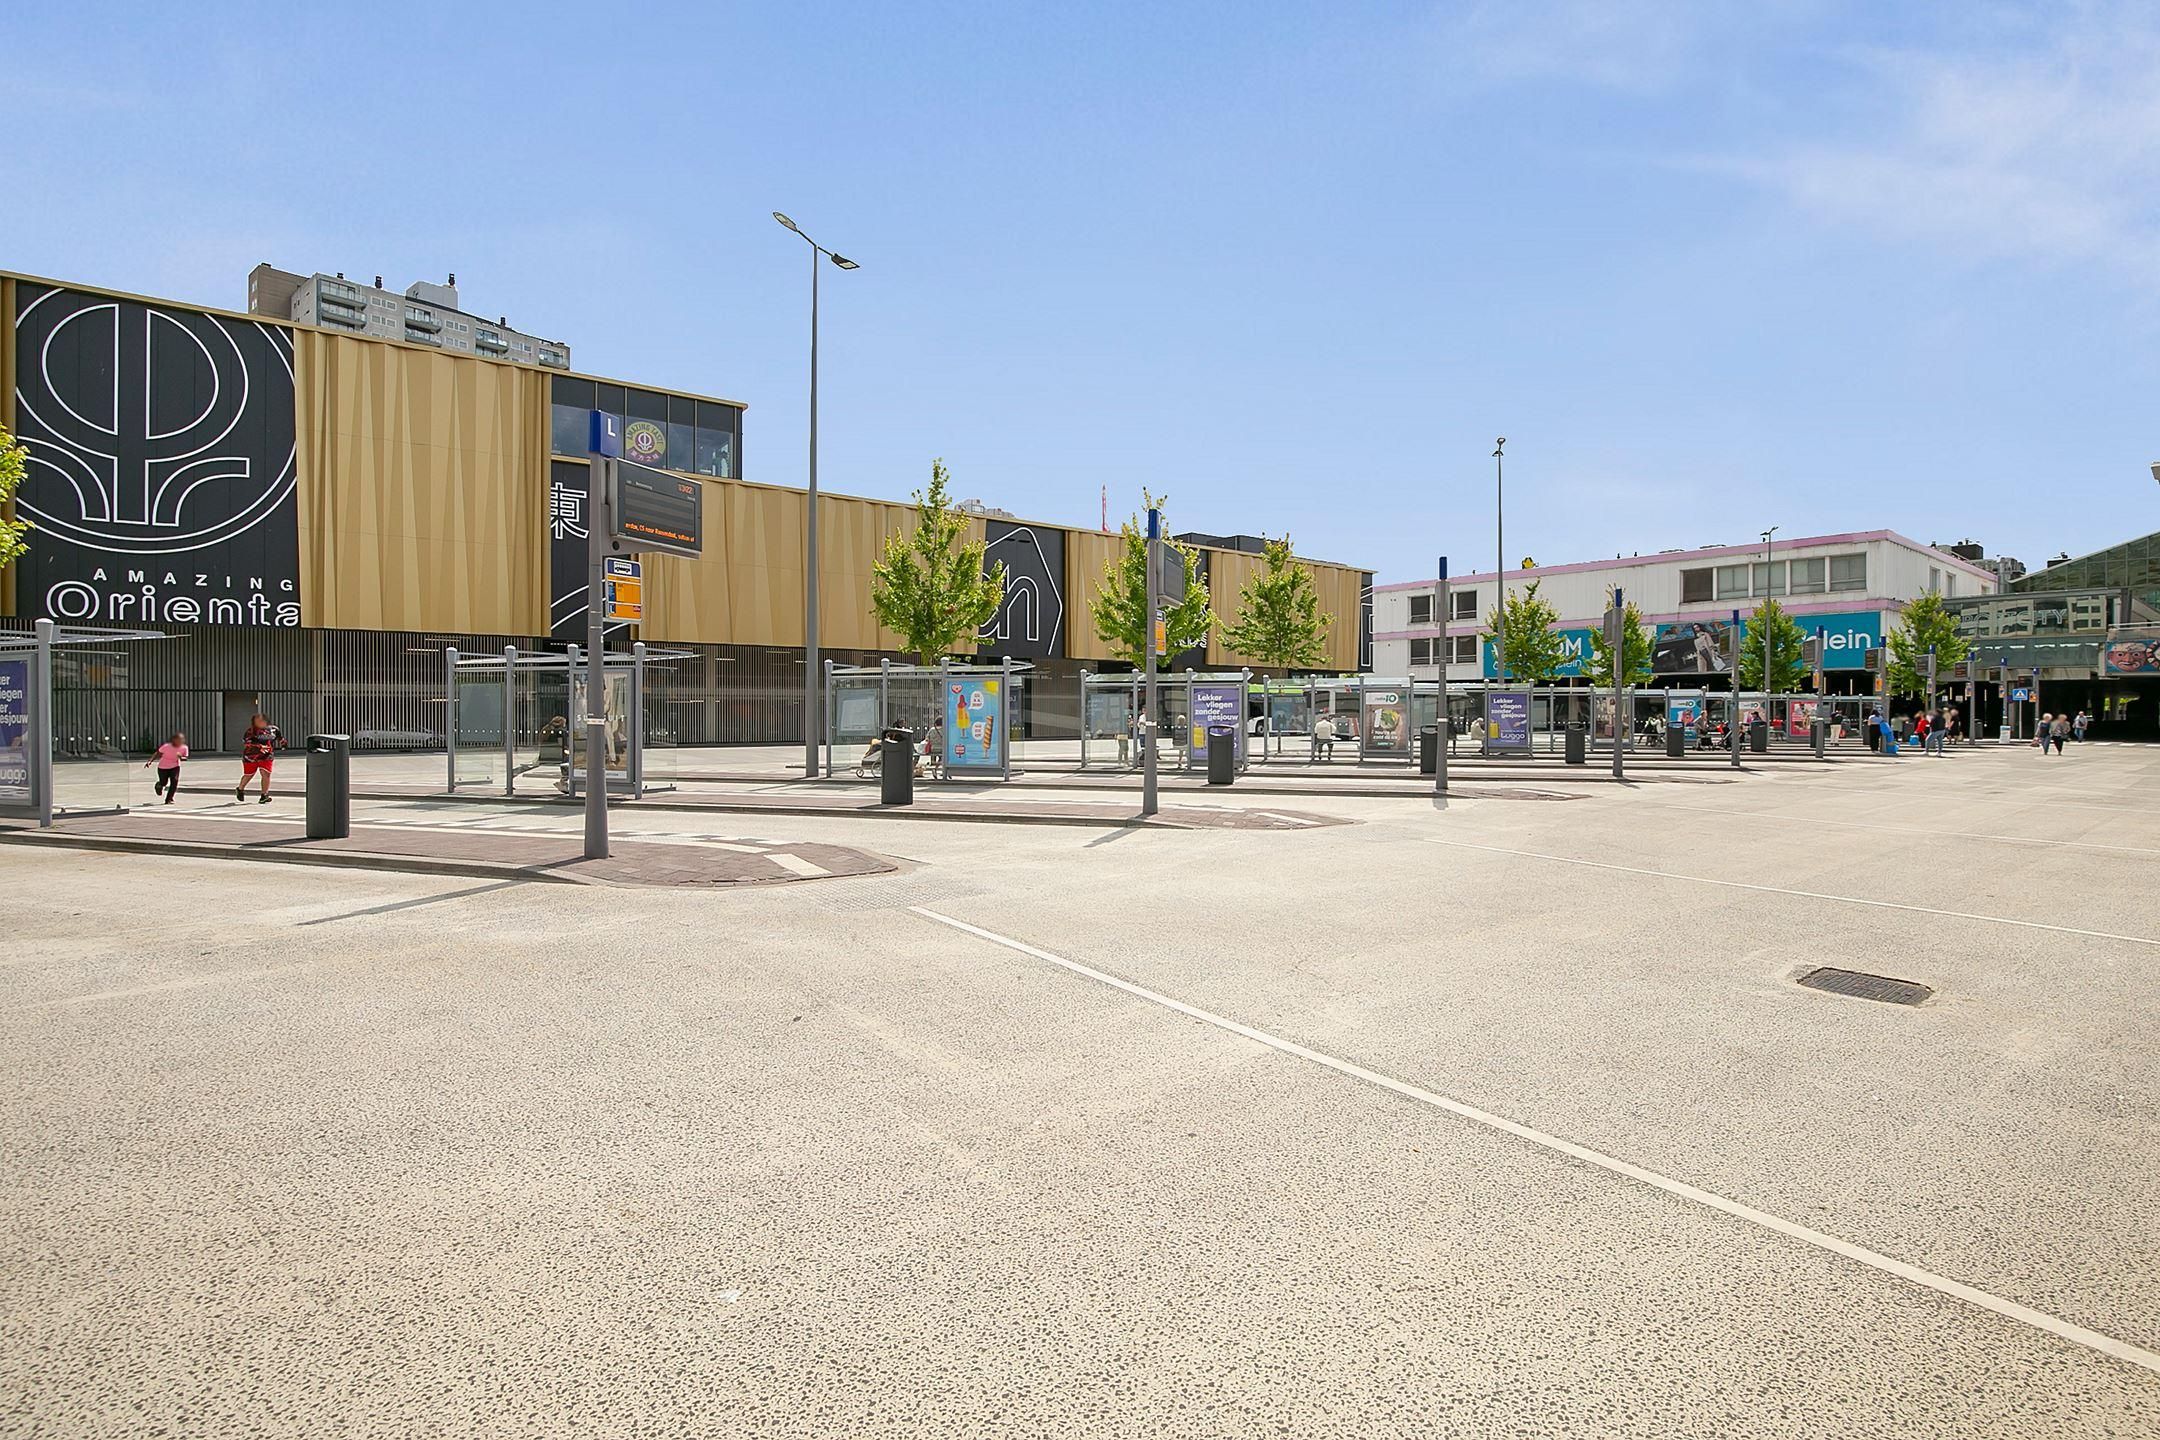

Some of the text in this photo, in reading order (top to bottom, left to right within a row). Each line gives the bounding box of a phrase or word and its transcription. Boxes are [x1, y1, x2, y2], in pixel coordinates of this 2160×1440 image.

[607, 418, 616, 437] L
[93, 568, 293, 591] AMAZING
[0, 688, 23, 702] iegen
[1197, 693, 1222, 701] Lekker
[1206, 701, 1233, 709] vliegen
[1208, 713, 1239, 721] gesjouw
